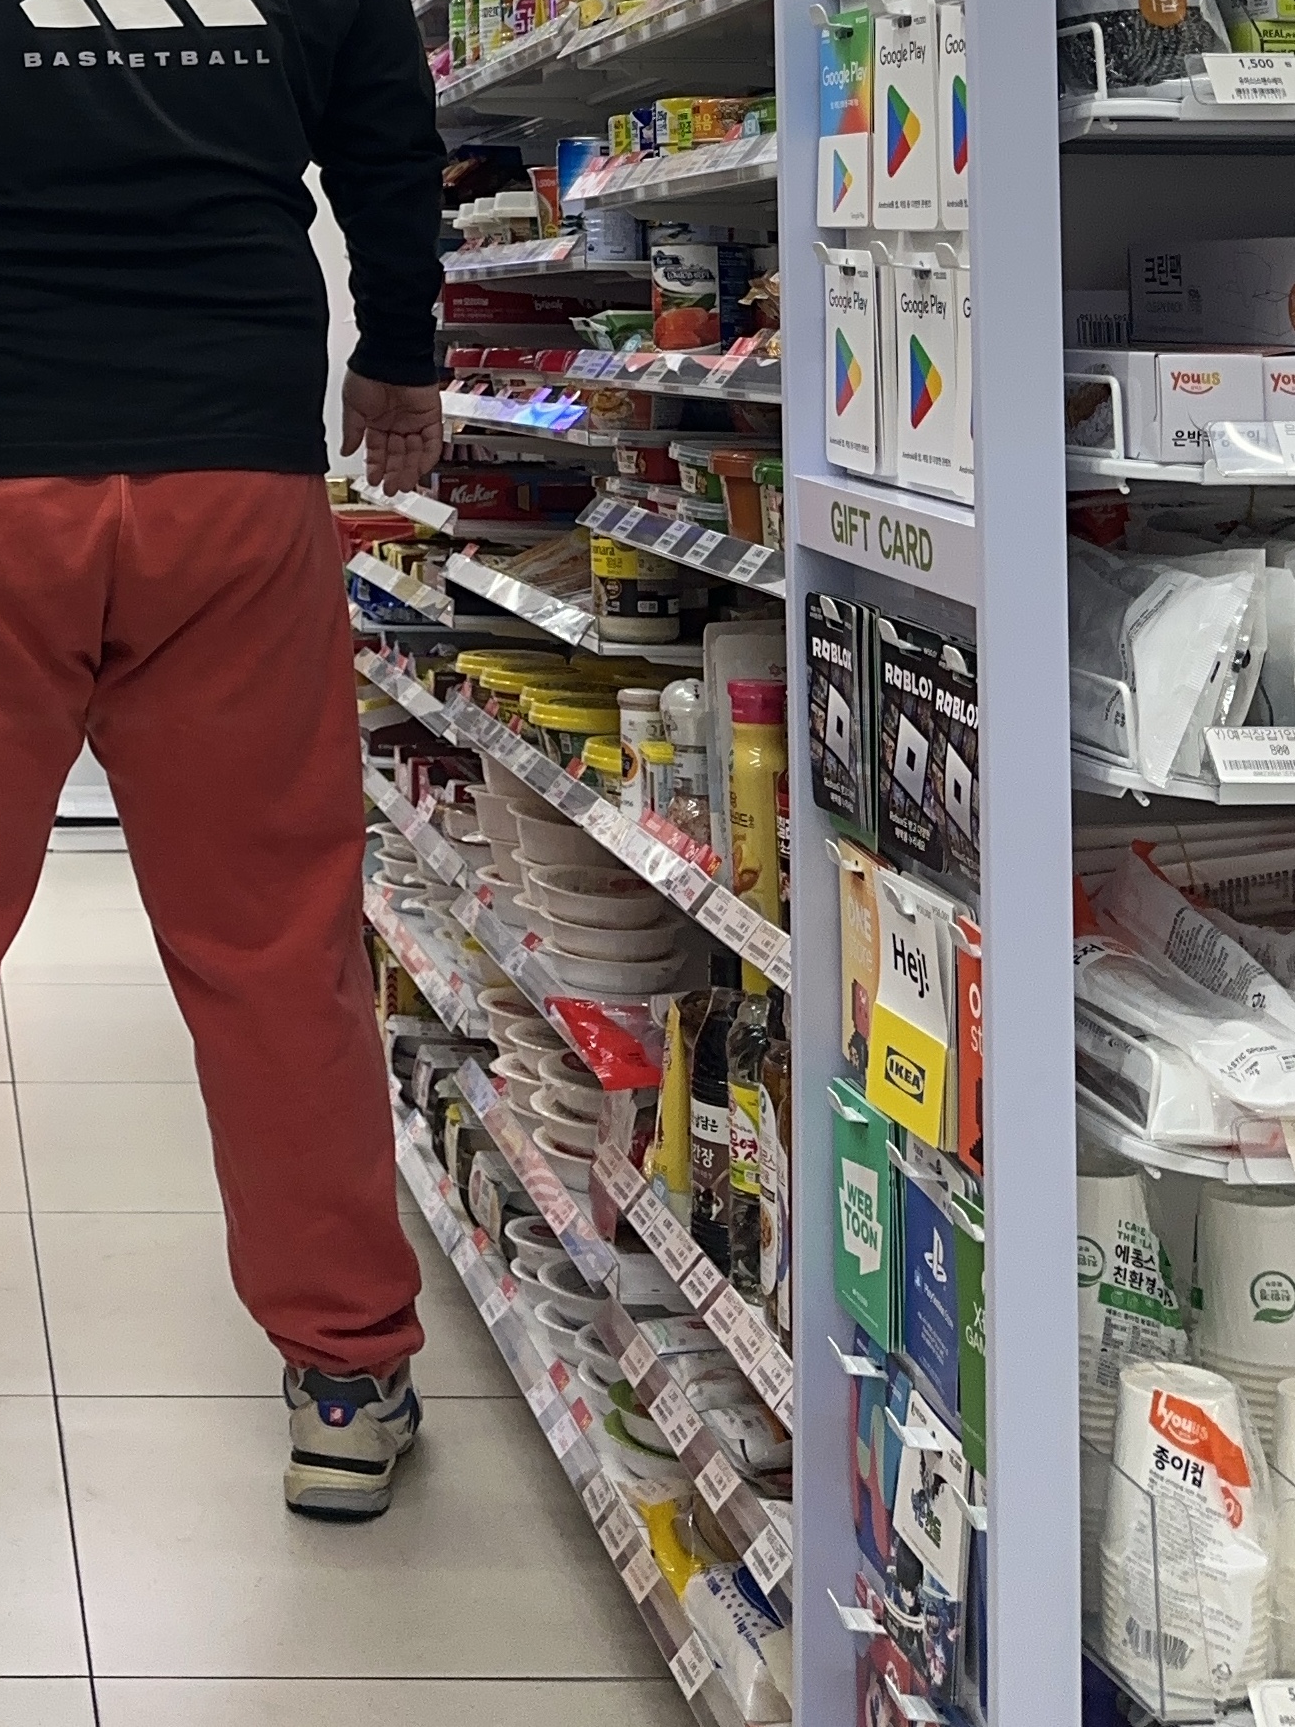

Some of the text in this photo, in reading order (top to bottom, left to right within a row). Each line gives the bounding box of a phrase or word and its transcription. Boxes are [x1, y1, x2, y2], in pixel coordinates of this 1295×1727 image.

[1263, 28, 1285, 39] REAL
[23, 49, 272, 69] BASKETBALL
[879, 40, 927, 69] Google Play
[1238, 58, 1275, 70] 1,500
[822, 61, 867, 90] Google Play
[1144, 253, 1183, 287] 크린팩
[828, 287, 868, 316] Google Play
[900, 292, 947, 319] Google Play
[1171, 371, 1222, 391] youus
[830, 500, 934, 574] GIFT CARD
[811, 636, 853, 672] ROBLOX
[891, 931, 931, 999] Hej!
[888, 1057, 922, 1093] IKEA
[845, 1179, 874, 1223] WEB
[843, 1200, 879, 1253] TOON
[1152, 1444, 1205, 1489] 종이컵
